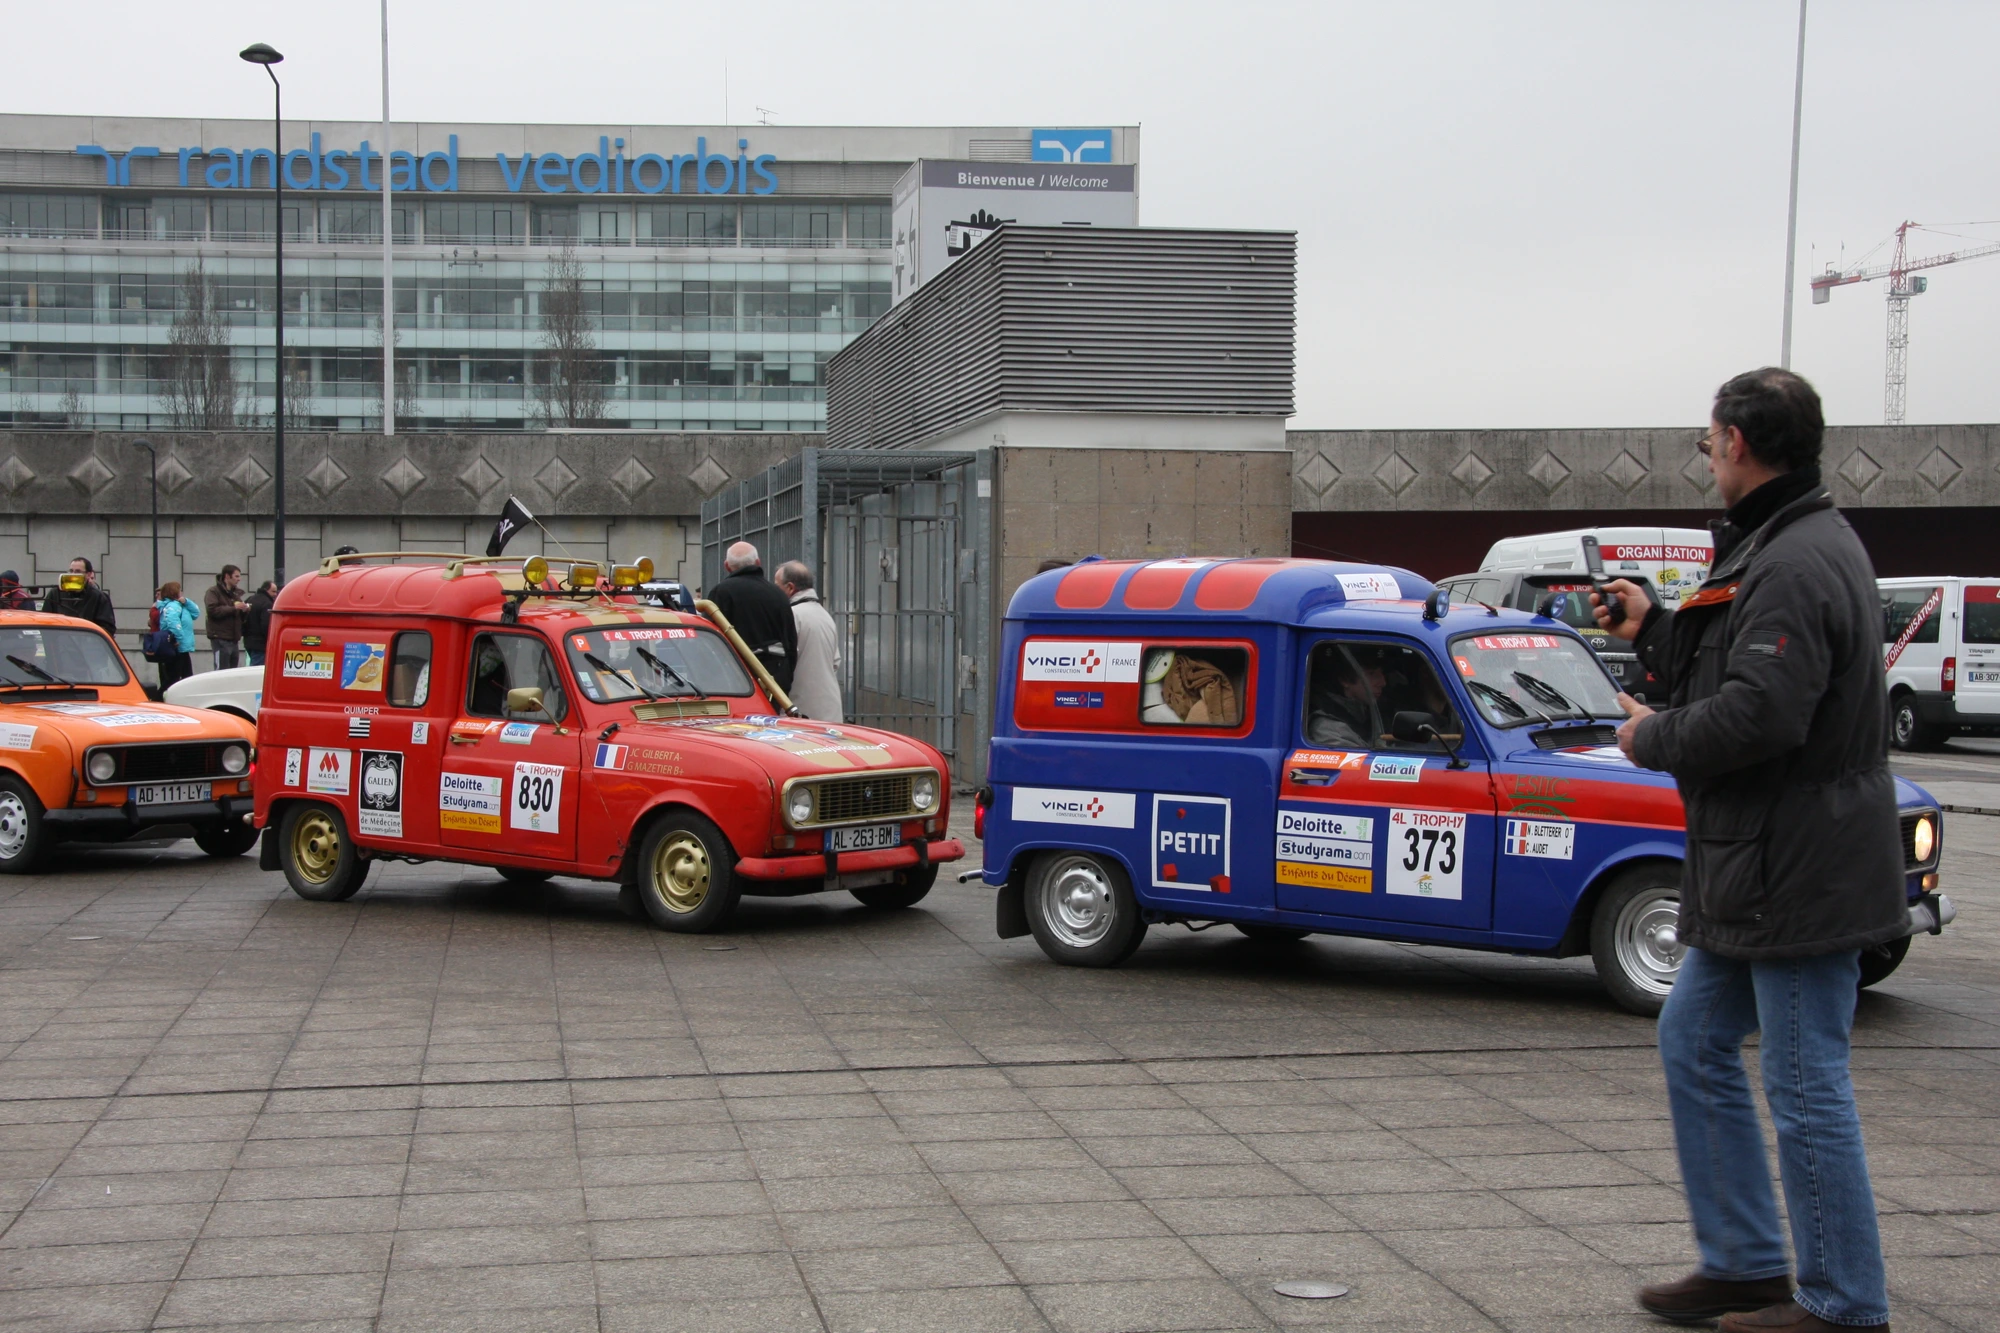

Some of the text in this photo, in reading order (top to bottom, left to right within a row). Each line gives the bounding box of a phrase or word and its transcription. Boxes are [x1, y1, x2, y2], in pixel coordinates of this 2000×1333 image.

[178, 132, 778, 195] randstad vediorbis
[957, 172, 1109, 189] Bienvenue / Welcome
[1616, 546, 1706, 561] ORGANISATION
[1344, 581, 1369, 589] VINCI
[1889, 591, 1940, 660] ORGANISATION
[614, 632, 627, 641] 4L
[629, 630, 663, 640] TROPHY
[665, 629, 686, 639] 2010
[576, 638, 585, 648] P
[1484, 637, 1550, 649] 4L TROPHY 2010
[284, 652, 313, 670] NGP
[1027, 656, 1076, 667] VINCI
[1111, 657, 1137, 667] FRANCE
[1459, 660, 1468, 672] P
[344, 706, 380, 716] QUIMPER
[504, 727, 532, 738] Sidi ali
[630, 748, 641, 757] JC
[642, 749, 674, 761] GILBERT
[516, 764, 563, 777] 4L TROPHY
[627, 761, 685, 775] G MAZETIER B+
[1373, 763, 1417, 777] Sidi ali
[367, 776, 394, 786] GALIEN
[1514, 774, 1571, 798] ESITC
[138, 784, 203, 803] AD-111-LY
[518, 775, 554, 813] 830
[1041, 801, 1083, 812] VINCI
[360, 816, 401, 828] de Médecine
[443, 813, 498, 828] Enfants du Désert
[1392, 811, 1465, 828] 4L TROPHY
[833, 826, 893, 850] AL-263-BM
[1160, 830, 1221, 856] PETIT
[1402, 827, 1457, 875] 373
[1531, 843, 1549, 855] AUDET
[1281, 865, 1319, 880] Enfants
[1321, 871, 1334, 880] du
[1336, 871, 1367, 885] Désert
[1419, 882, 1433, 891] ESC
